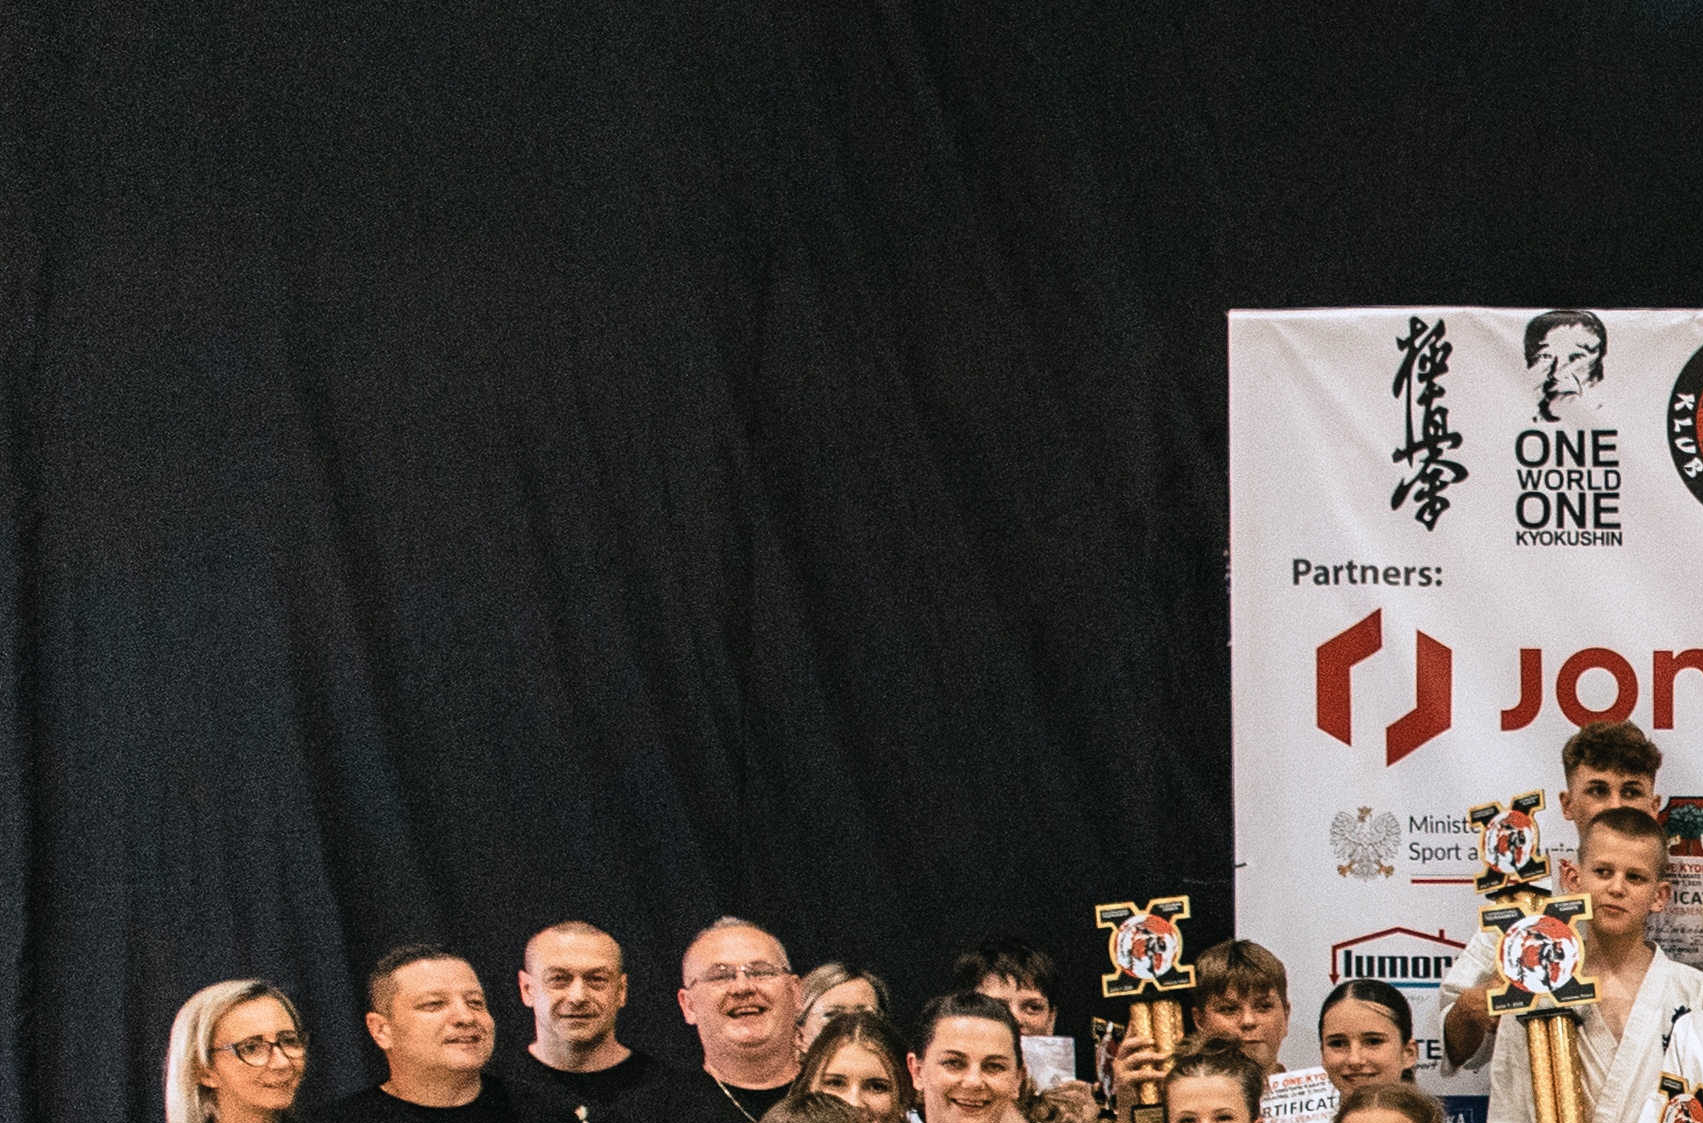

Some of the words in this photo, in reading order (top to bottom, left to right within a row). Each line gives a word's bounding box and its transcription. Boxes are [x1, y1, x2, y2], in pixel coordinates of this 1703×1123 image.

[1515, 430, 1619, 468] ONE
[1674, 393, 1703, 478] KLUB
[1517, 470, 1621, 491] WORLD
[1515, 492, 1620, 530] ONE
[1515, 531, 1623, 547] KYOKUSHIN
[1292, 558, 1443, 588] Partners:
